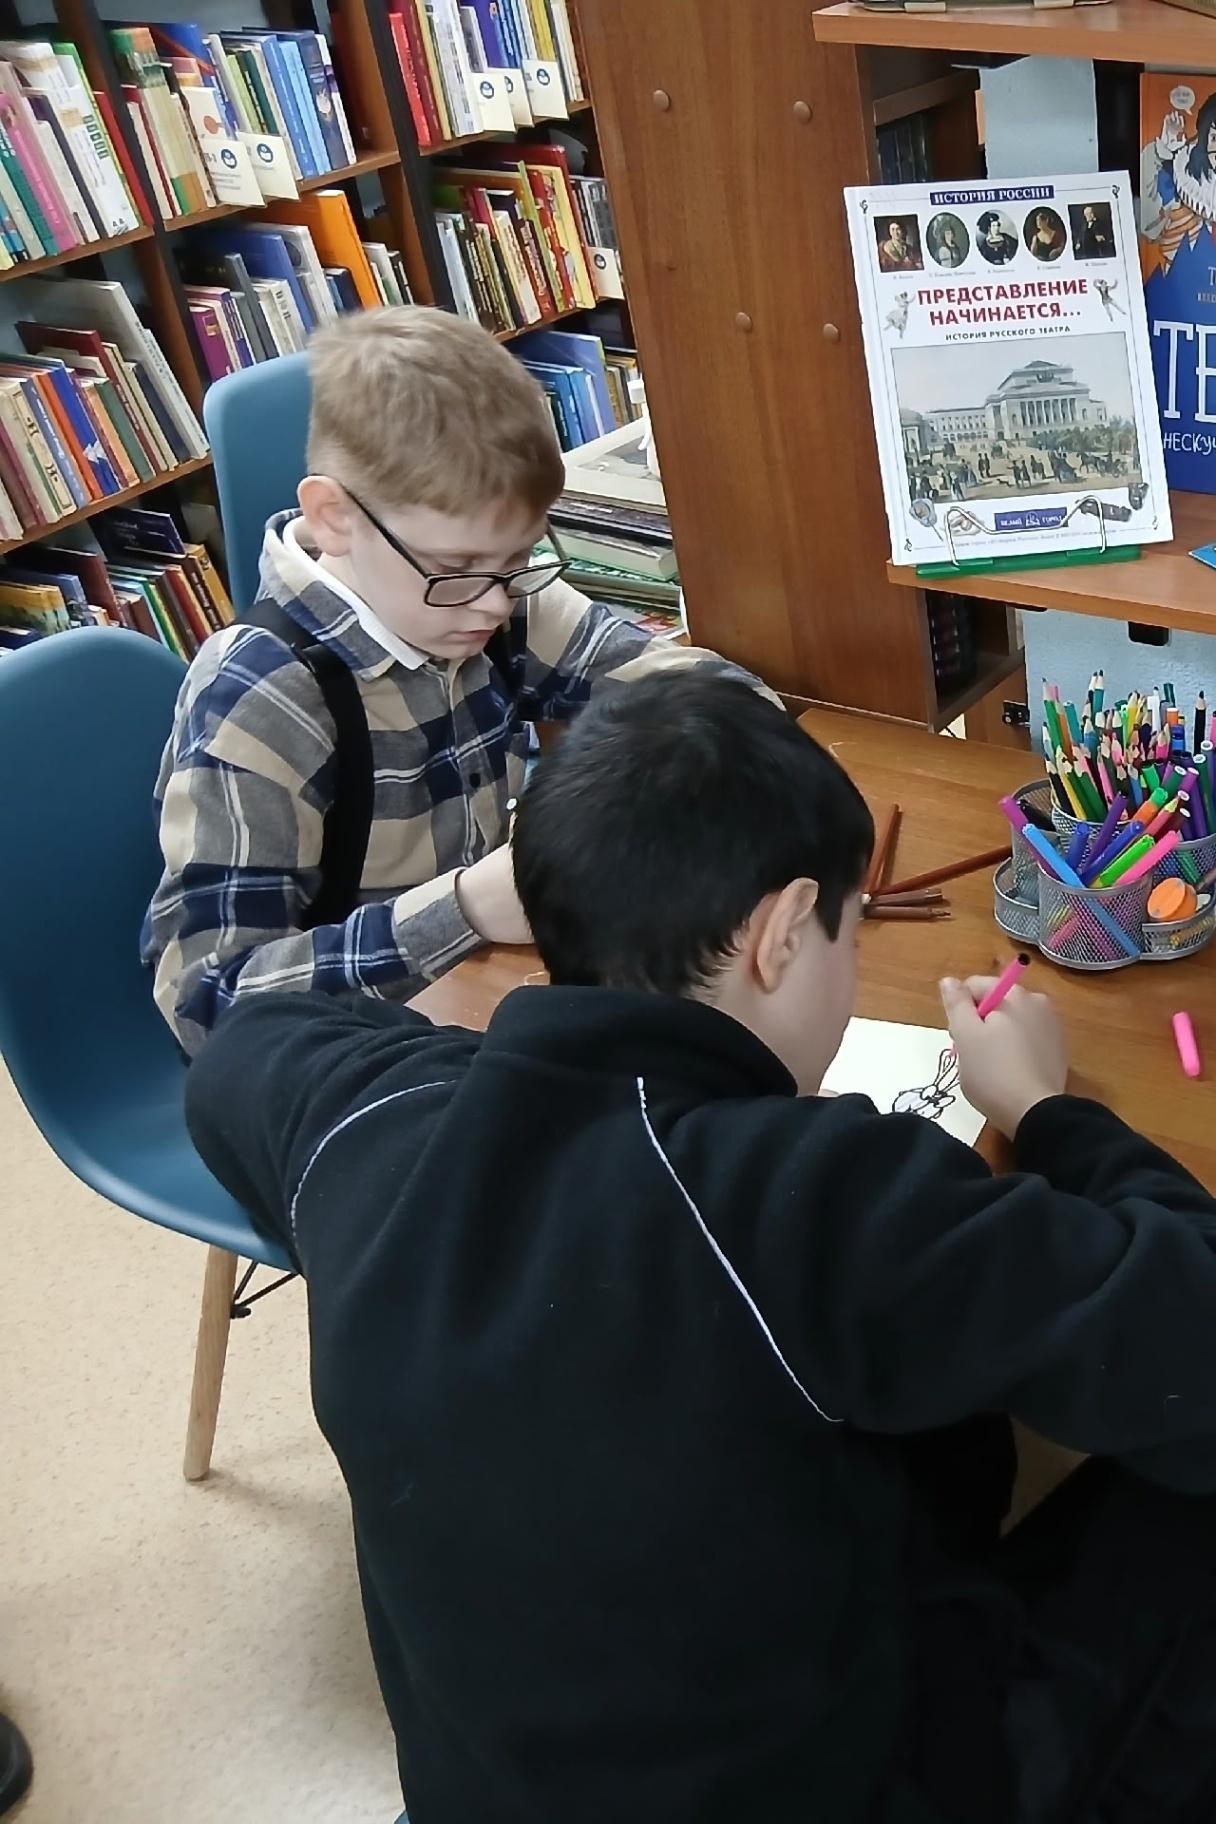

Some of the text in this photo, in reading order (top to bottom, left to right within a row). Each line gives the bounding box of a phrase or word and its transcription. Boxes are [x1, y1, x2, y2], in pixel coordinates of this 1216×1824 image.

[934, 187, 1050, 204] ИСТОРИЯ РОССИИ
[917, 278, 1088, 305] ПРЕДСТАВЛЕНИЕ
[929, 302, 1081, 326] НАЧИНАЕТСЯ...
[945, 325, 1071, 341] ИСТОРИЯ РУССКОГО ТЕАТРА
